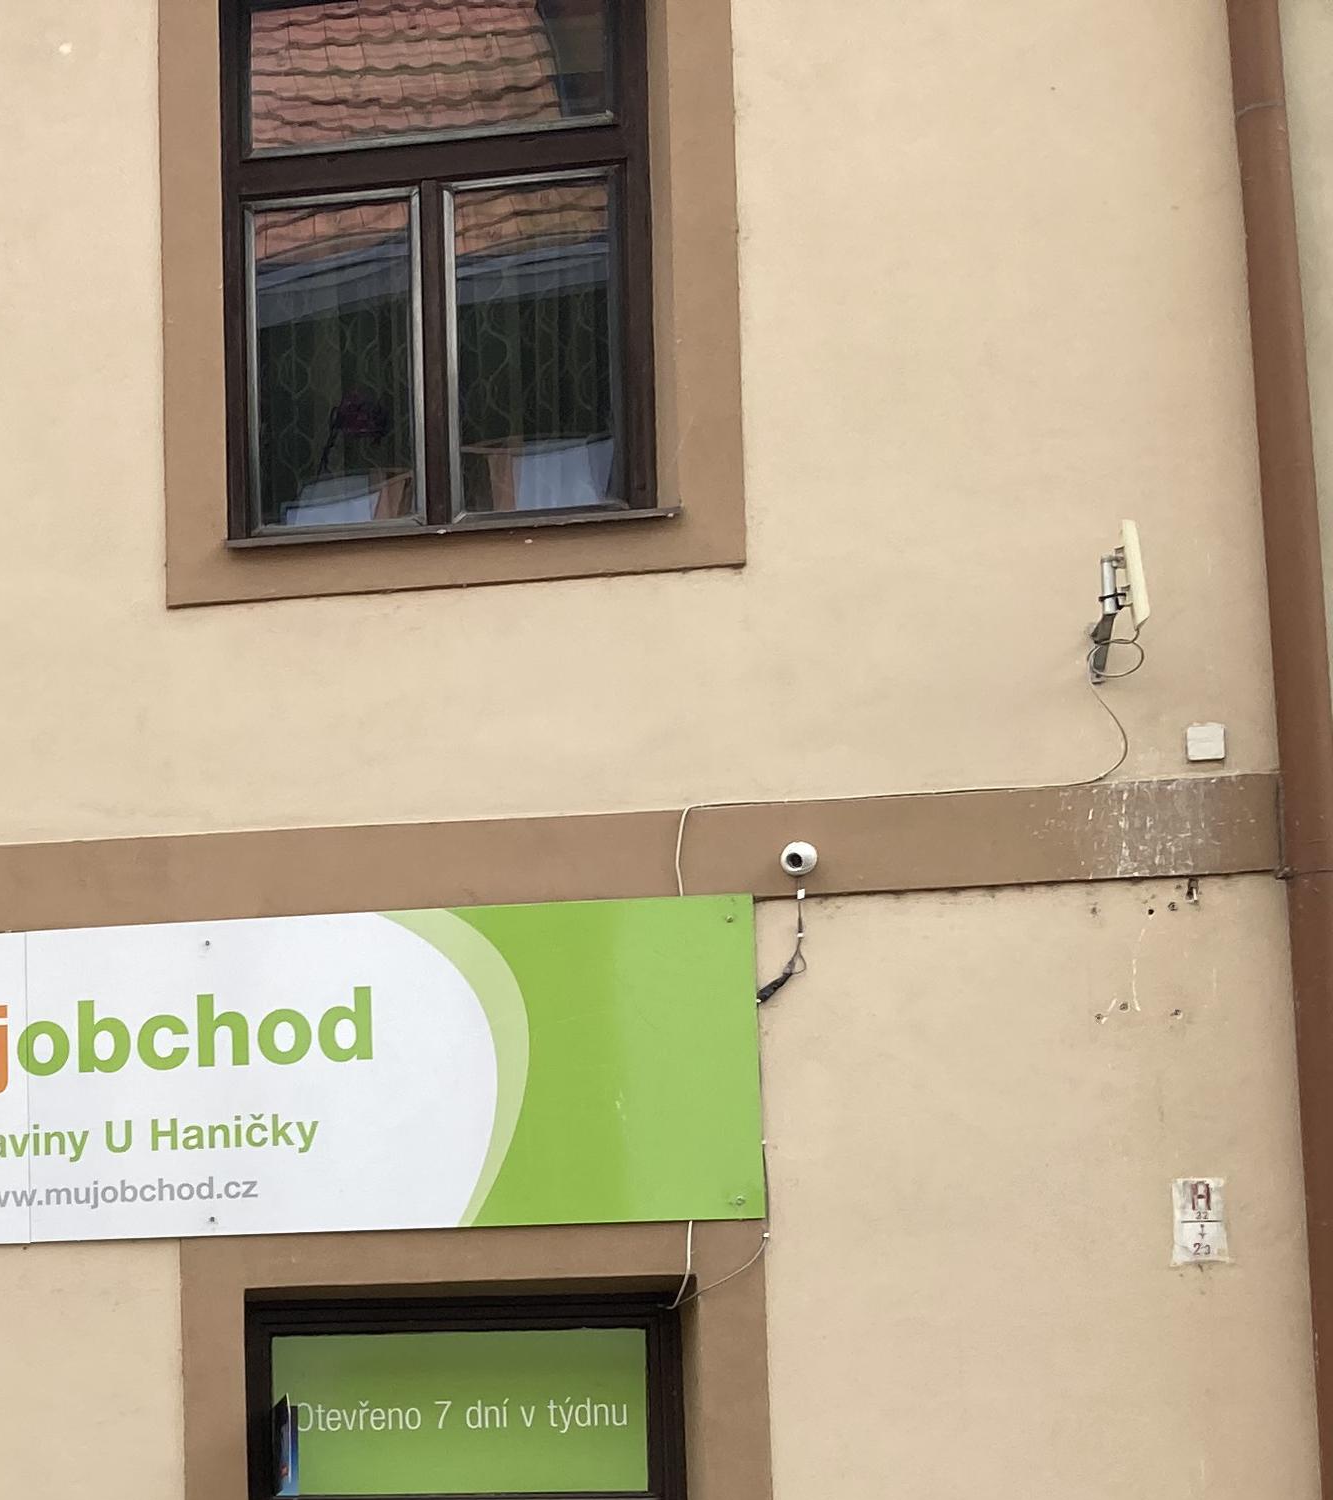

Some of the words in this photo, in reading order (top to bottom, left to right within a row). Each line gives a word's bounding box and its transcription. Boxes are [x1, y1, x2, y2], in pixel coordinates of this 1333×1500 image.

[104, 1120, 133, 1154] U
[150, 1113, 319, 1155] Haničky
[297, 1400, 422, 1432] Otevřeno
[434, 1401, 453, 1429] 7
[465, 1398, 509, 1429] dní
[519, 1404, 536, 1428] v
[548, 1396, 629, 1433] týdnu
